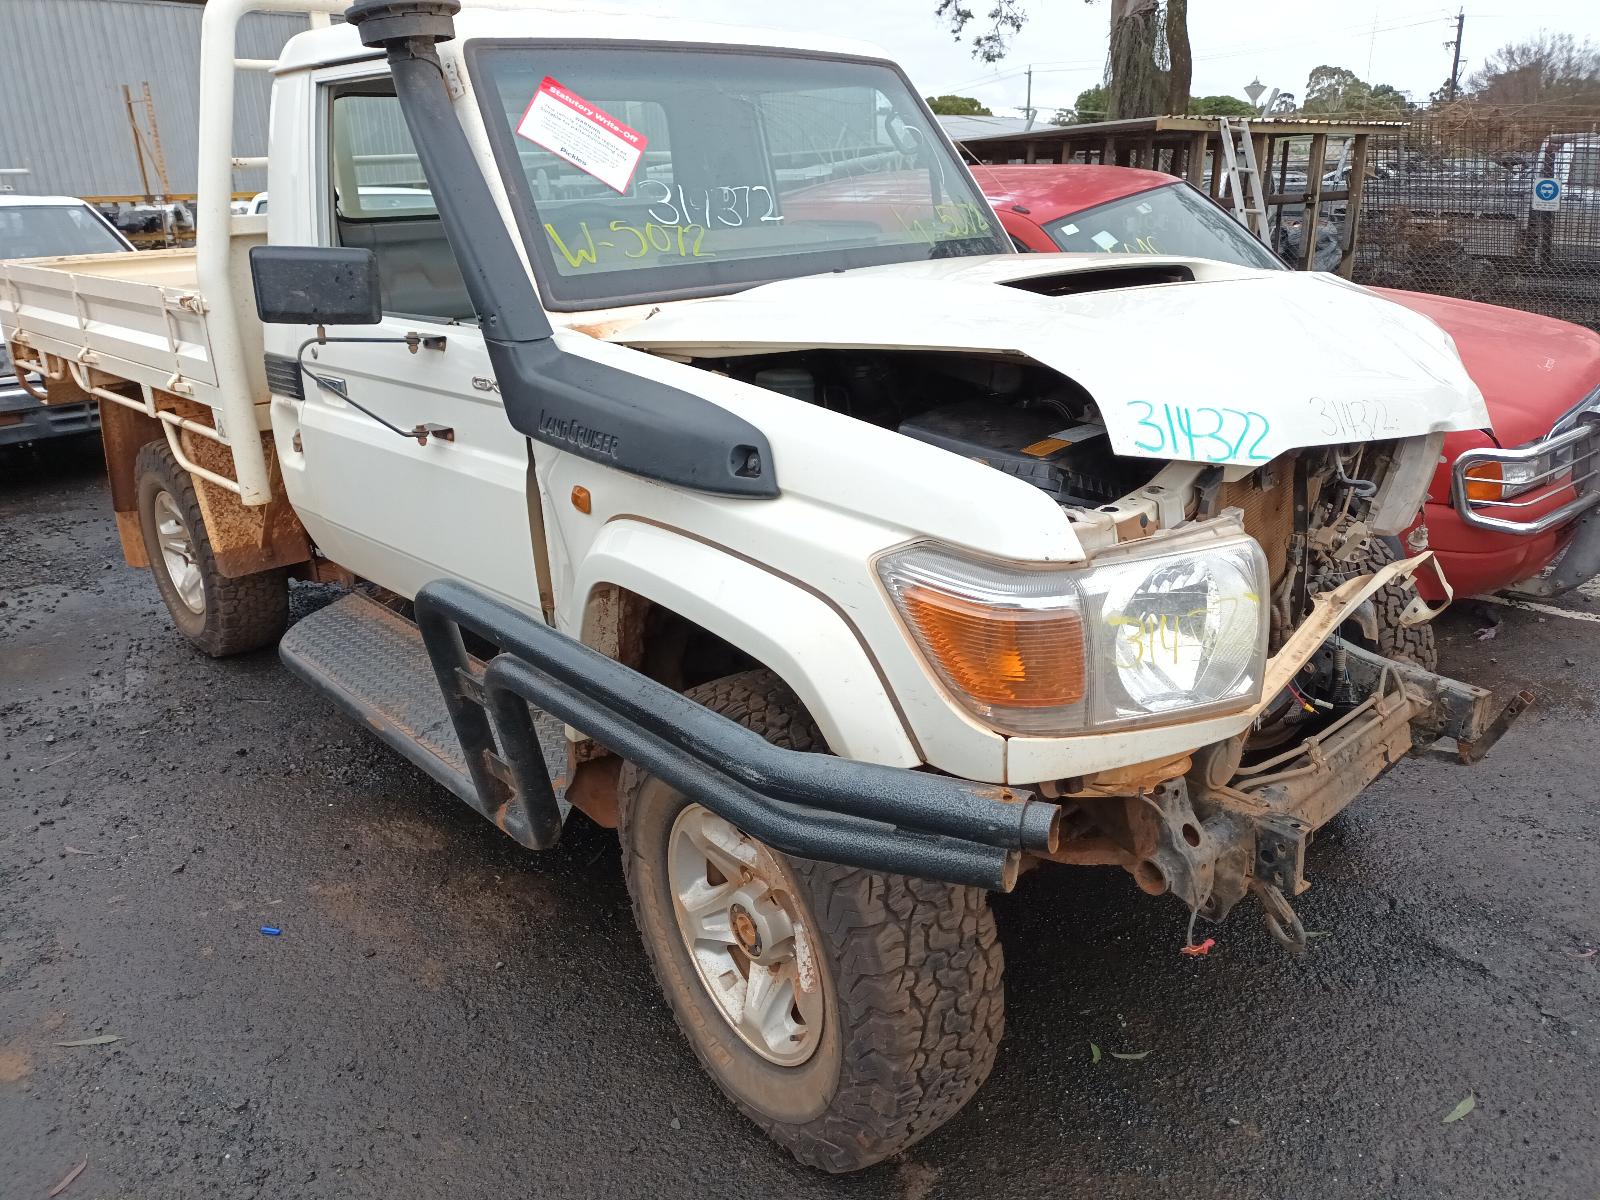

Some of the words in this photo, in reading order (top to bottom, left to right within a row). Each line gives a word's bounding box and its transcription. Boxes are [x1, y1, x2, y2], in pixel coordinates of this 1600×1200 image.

[549, 86, 593, 116] Statutory
[595, 113, 639, 142] Write-Off
[559, 146, 587, 166] Pickles
[1127, 400, 1272, 463] 314372
